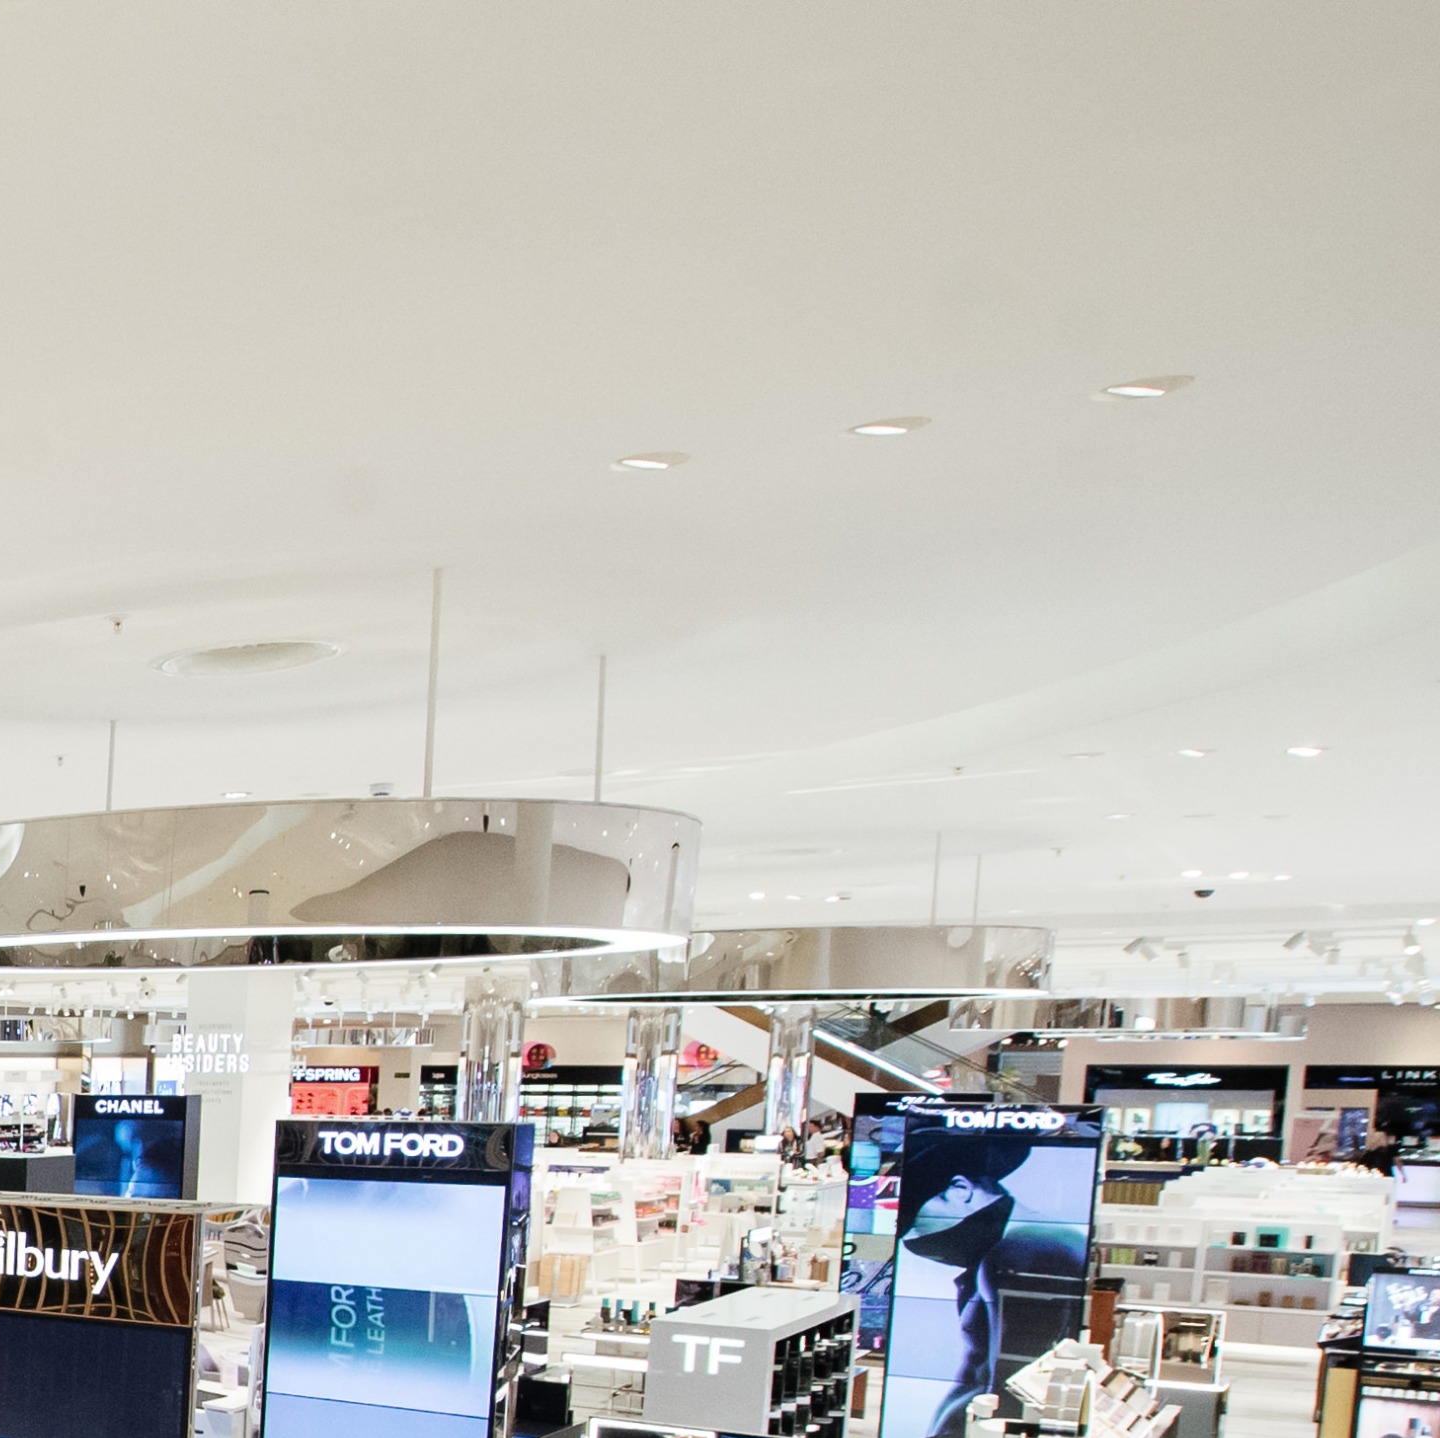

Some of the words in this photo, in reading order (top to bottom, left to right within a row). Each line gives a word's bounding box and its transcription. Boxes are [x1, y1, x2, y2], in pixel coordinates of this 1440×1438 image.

[172, 1033, 244, 1052] BEAUTY
[166, 1053, 250, 1074] INSIDERS
[1380, 1070, 1440, 1080] LINK
[95, 1099, 164, 1114] CHANEL
[942, 1111, 995, 1129] TOM
[996, 1111, 1065, 1130] FORD
[318, 1131, 382, 1156] TOM
[384, 1132, 465, 1158] FORD
[671, 1334, 745, 1375] TF
